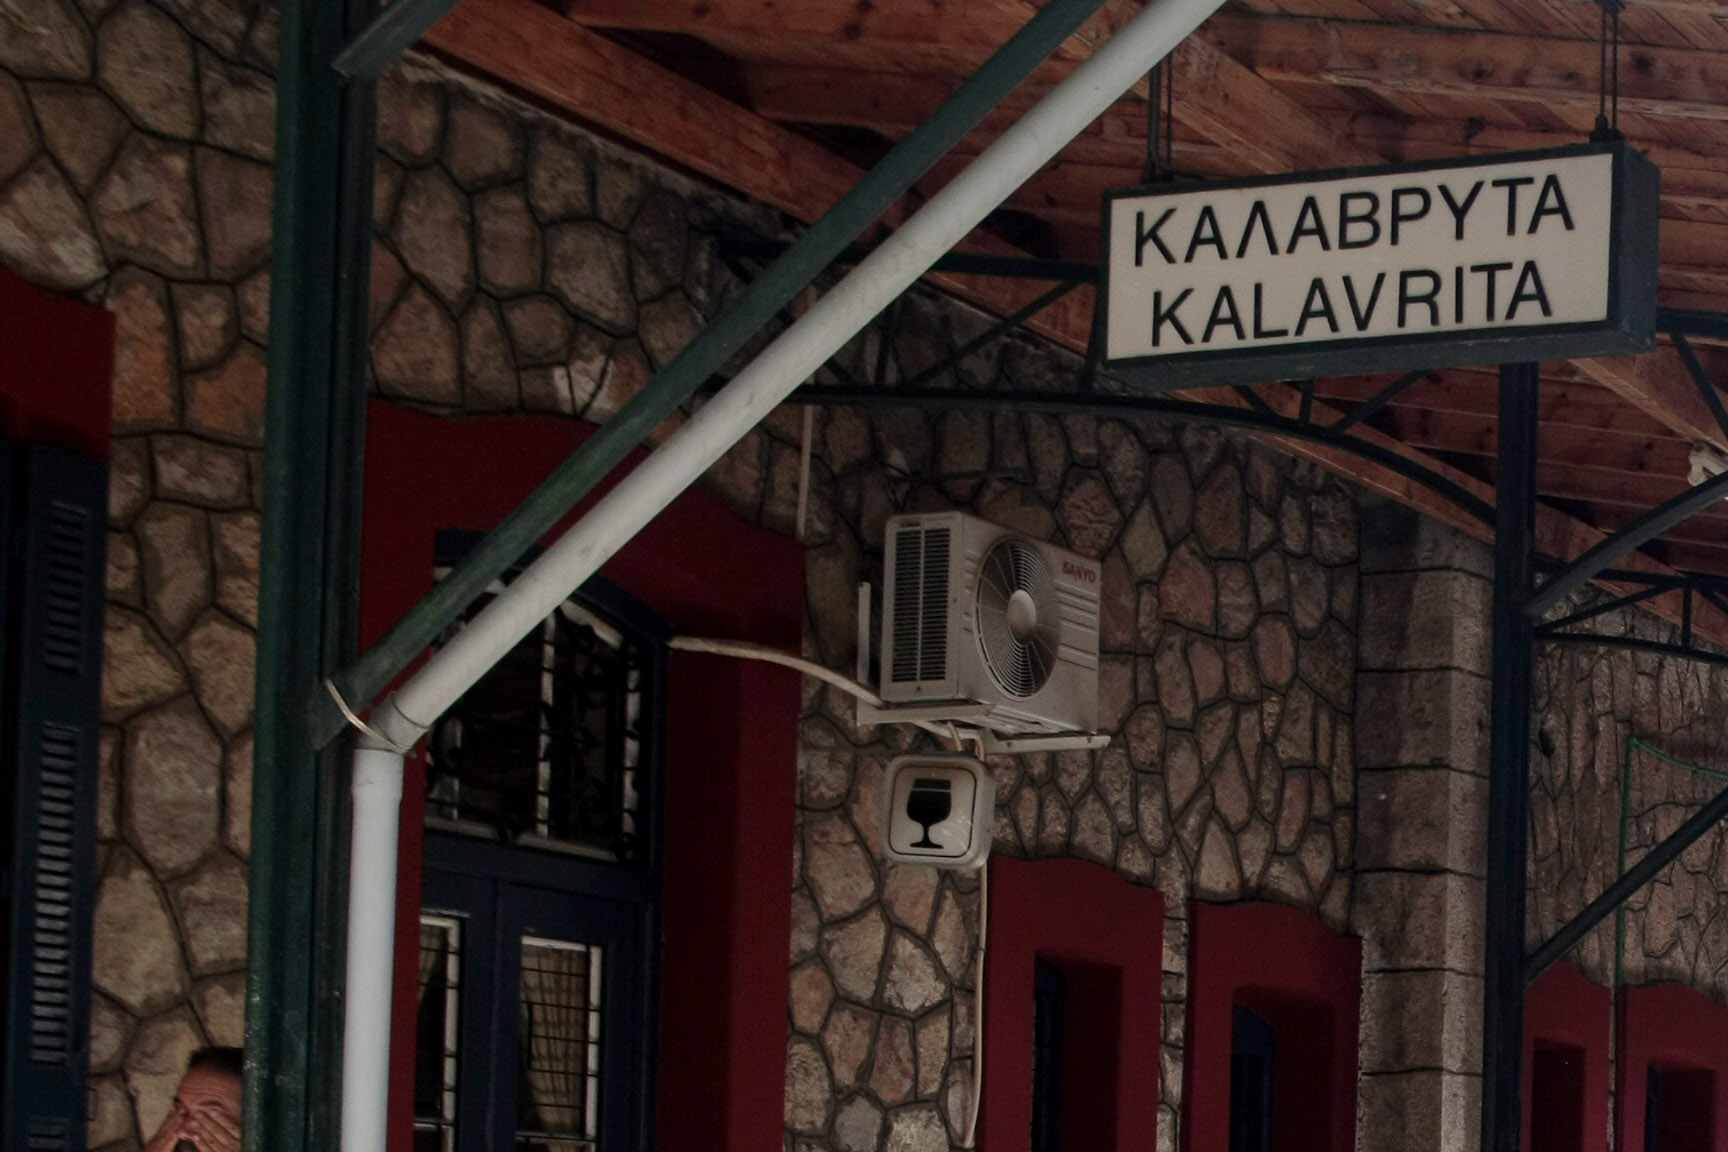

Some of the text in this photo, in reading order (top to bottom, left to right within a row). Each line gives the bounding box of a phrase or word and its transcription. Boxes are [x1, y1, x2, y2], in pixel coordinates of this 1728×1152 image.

[1134, 173, 1575, 267] ΚΑΛΑΒΡΥΤΑ
[1151, 259, 1553, 347] KALAVRITA
[1062, 560, 1096, 583] SANYO
